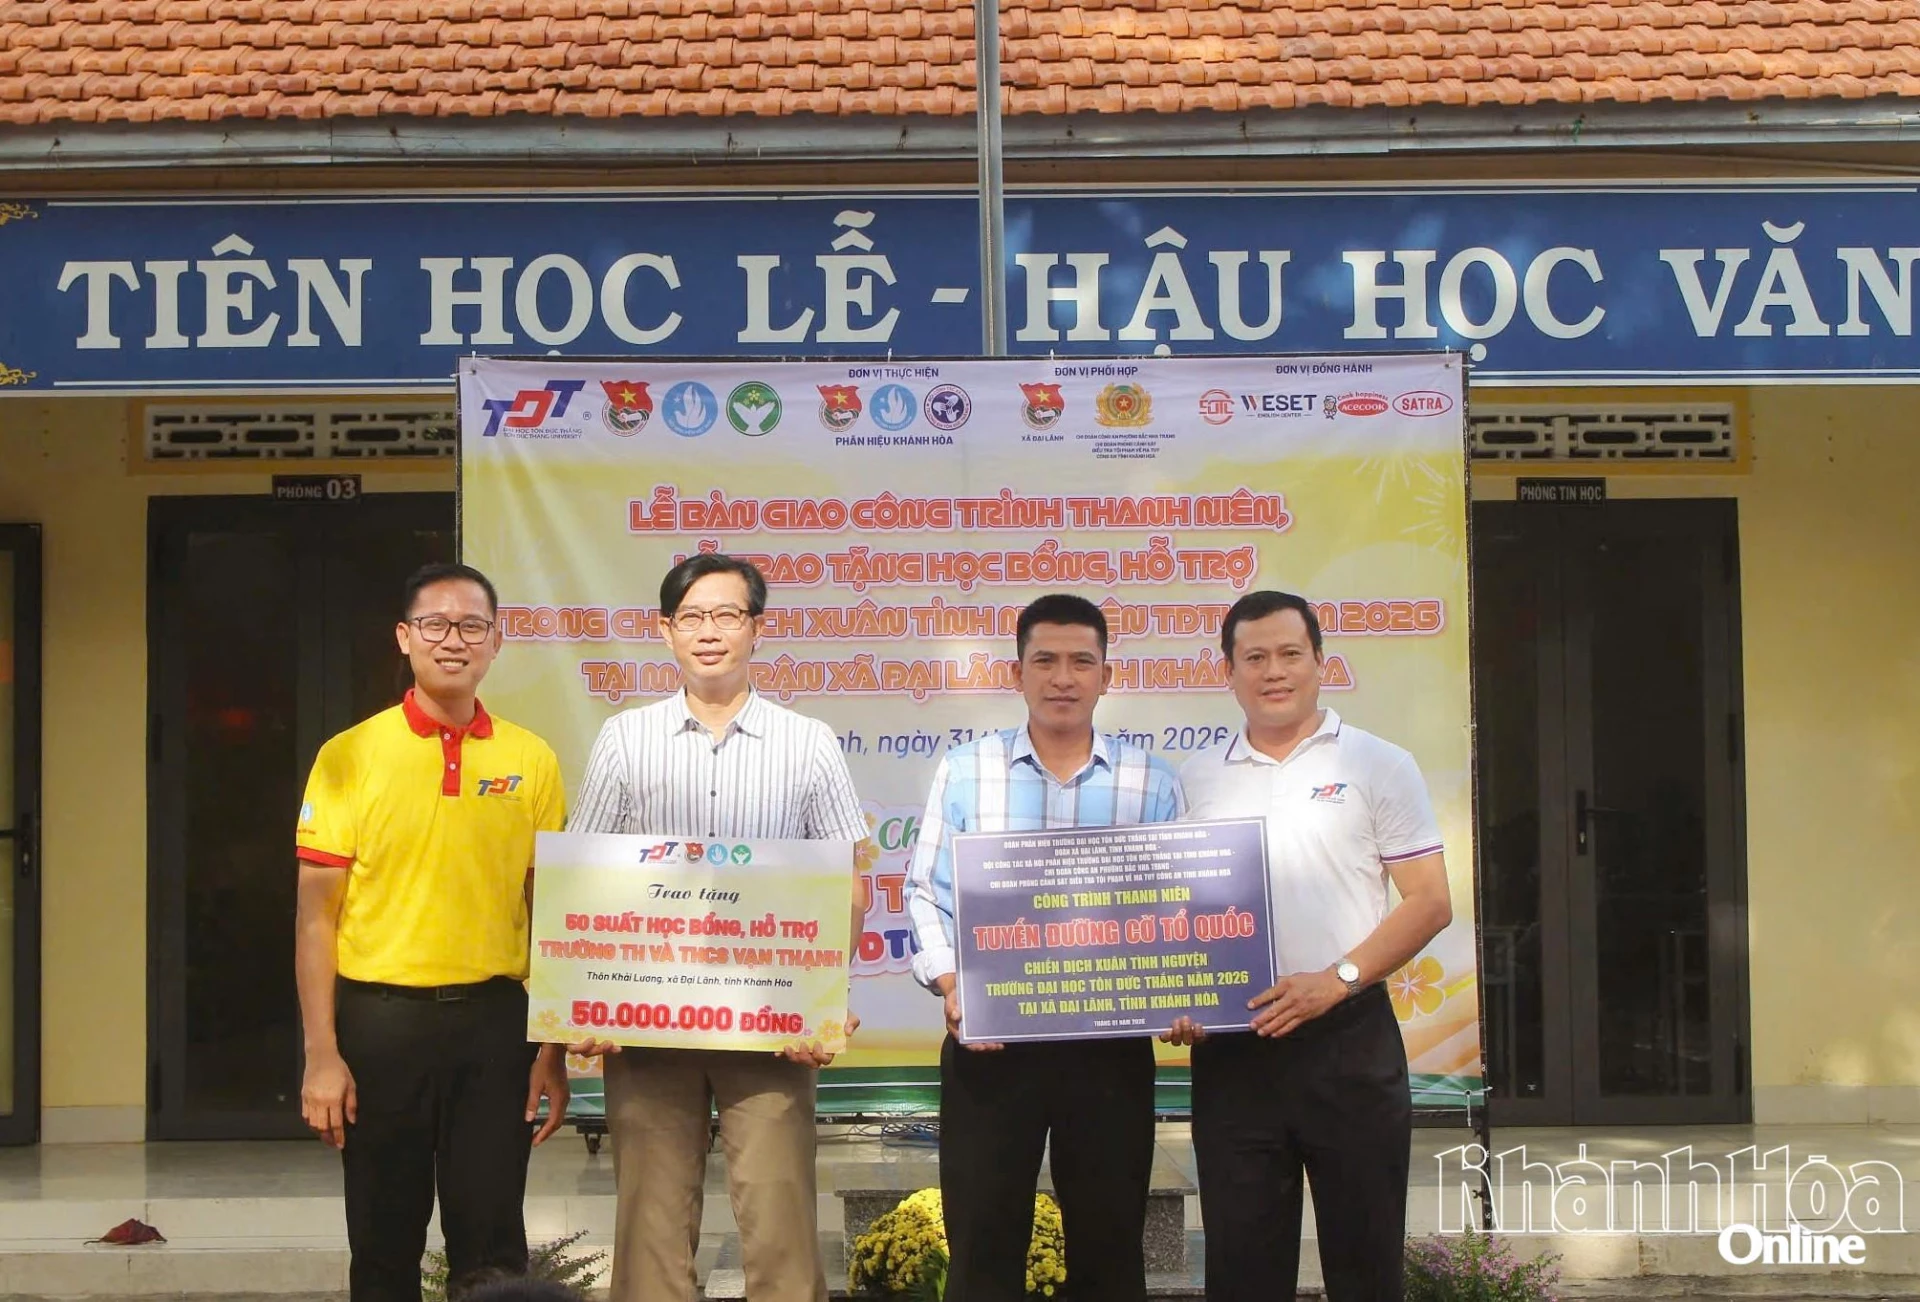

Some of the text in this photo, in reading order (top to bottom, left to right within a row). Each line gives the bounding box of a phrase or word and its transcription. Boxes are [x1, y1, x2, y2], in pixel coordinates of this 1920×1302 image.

[420, 253, 683, 356] HỌC
[737, 210, 900, 344] LỄ
[1016, 226, 1290, 356] HẬU
[1343, 246, 1605, 363] HỌC
[1660, 220, 1920, 339] VĂN
[849, 369, 870, 378] ĐƠN
[915, 368, 939, 379] HIỆN
[1055, 367, 1076, 376] ĐƠN
[1091, 364, 1115, 376] PHỐI
[1117, 366, 1138, 378] HỢP
[1276, 365, 1297, 374] ĐƠN
[1241, 394, 1317, 411] WESET
[1402, 398, 1443, 410] SATRA
[867, 436, 890, 448] HIỆU
[327, 479, 356, 499] 03
[1560, 485, 1577, 500] TIN
[1580, 485, 1602, 502] HỌC
[630, 486, 677, 530] LỄ
[762, 498, 848, 530] GIAO
[851, 490, 952, 530] CÔNG
[1067, 497, 1191, 527] THANH
[1195, 488, 1289, 529] NIÊN,
[826, 546, 923, 592] TẶNG
[927, 551, 1002, 591] HỌC
[1005, 539, 1117, 584] BỔNG,
[1120, 536, 1175, 580] HỖ
[1177, 547, 1254, 588] TRỢ
[806, 599, 906, 637] XUÂN
[1340, 601, 1440, 631] 2026
[582, 661, 636, 700] TẠI
[747, 654, 825, 700] RẬN
[827, 654, 880, 691] XÃ
[882, 660, 942, 699] ĐẠI
[945, 653, 1021, 690] LÃN
[878, 729, 940, 758] ngày
[647, 884, 740, 904] Trao tặng
[1033, 886, 1190, 909] CÔNG TRÌNH THANH NIÊN
[566, 914, 589, 931] 50
[593, 911, 643, 933] SUẤT
[647, 917, 686, 939] HỌC
[750, 913, 776, 937] HỖ
[780, 920, 818, 943] TRỢ
[973, 906, 1254, 950] TUYẾN ĐƯỜNG CỜ TỔ QUỐC
[538, 939, 843, 971] TRƯỜNG TH VÀ THCS VẠN THẠNH
[1024, 951, 1208, 975] CHIẾN DỊCH XUÂN TÌNH NGUYỆN
[587, 971, 609, 981] Thôn
[986, 971, 1249, 996] TRƯỜNG ĐẠI HỌC TÔN ĐỨC THẮNG NĂM 2026
[1018, 1001, 1037, 1017] TẠI
[1041, 999, 1056, 1014] XÃ
[1060, 1000, 1080, 1015] ĐẠI
[1119, 994, 1146, 1010] TỈNH
[1150, 993, 1191, 1009] KHÁNH
[1194, 991, 1219, 1006] HÒA
[572, 1001, 804, 1034] 50.000.000 ĐỒNG
